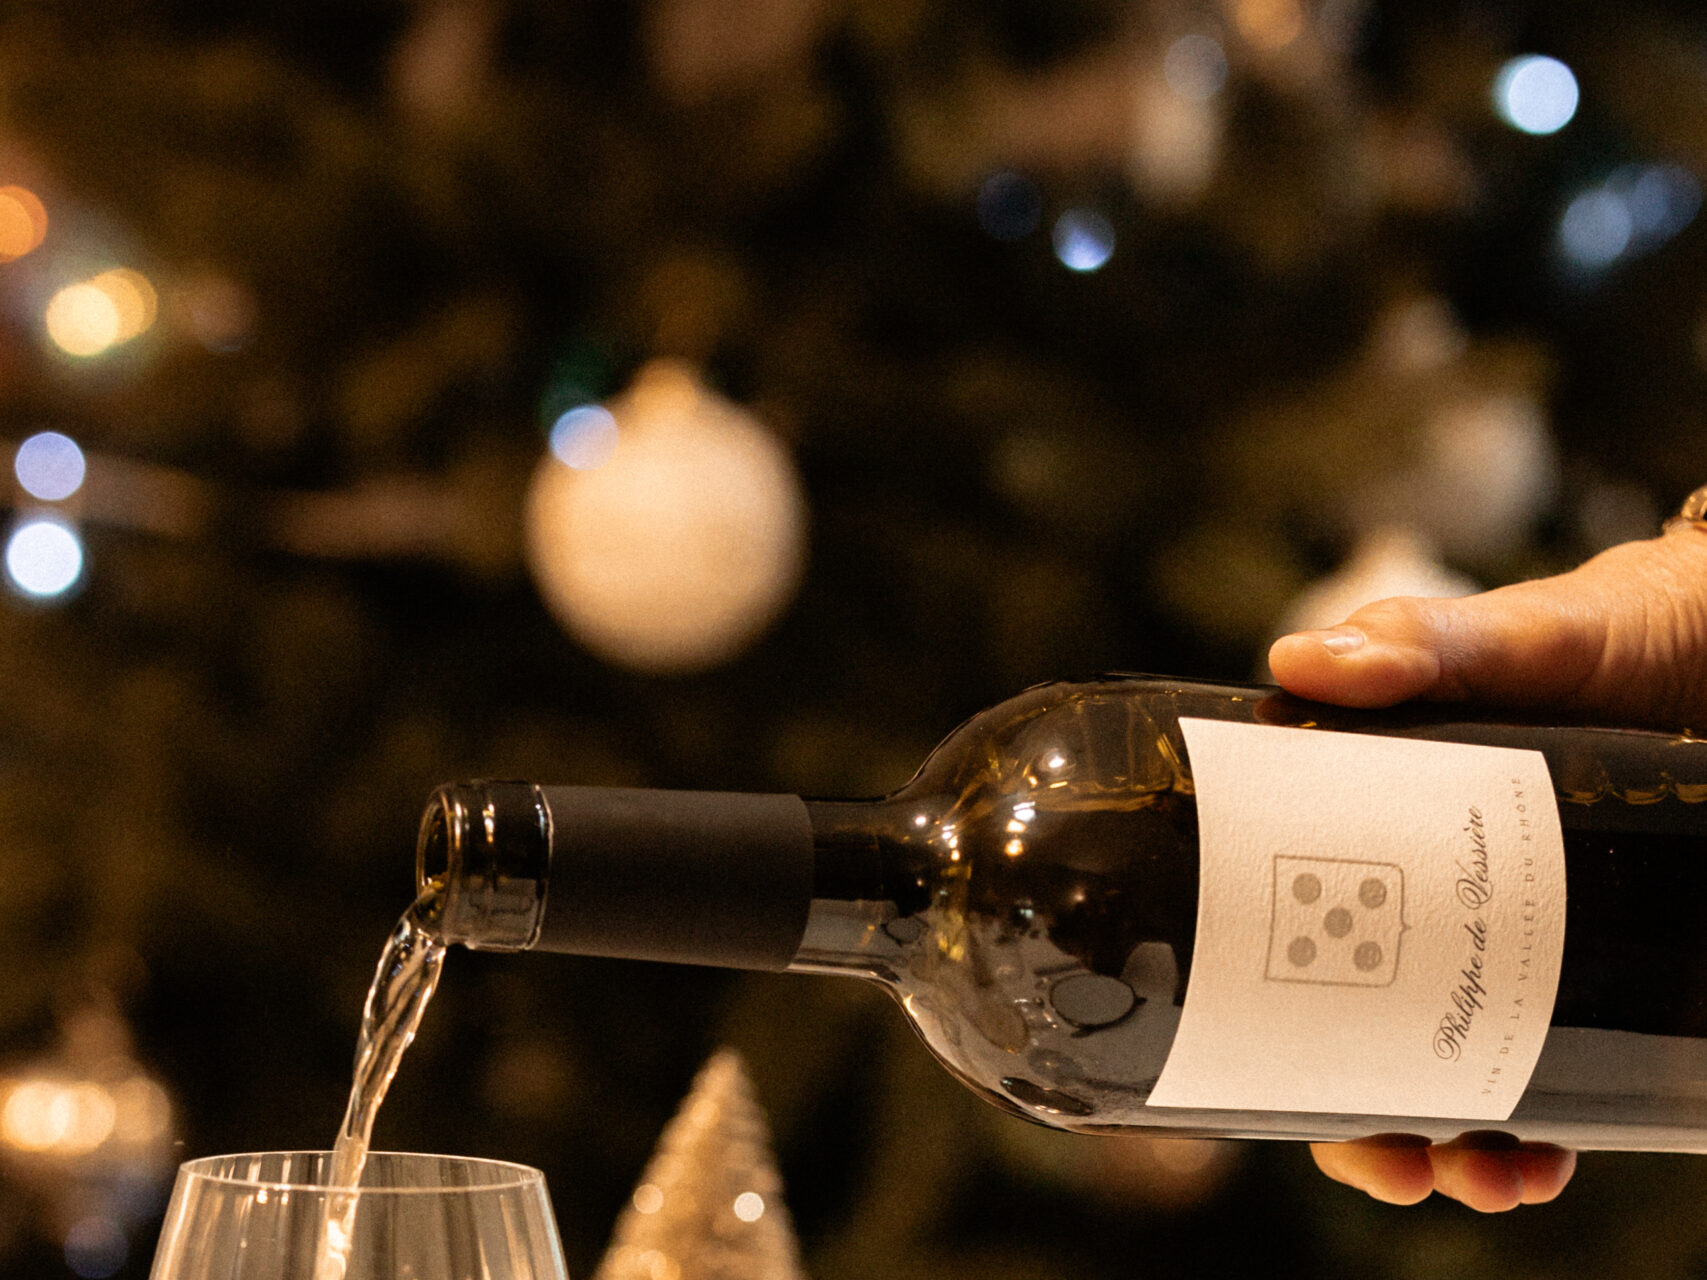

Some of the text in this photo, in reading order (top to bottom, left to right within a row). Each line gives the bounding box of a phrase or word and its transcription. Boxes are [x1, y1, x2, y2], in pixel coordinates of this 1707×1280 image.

[1433, 805, 1494, 1063] Philippe de Vessière
[1481, 1067, 1502, 1095] VIN
[1499, 1034, 1514, 1055] DE
[1510, 998, 1525, 1020] LA
[1523, 857, 1535, 882] DU
